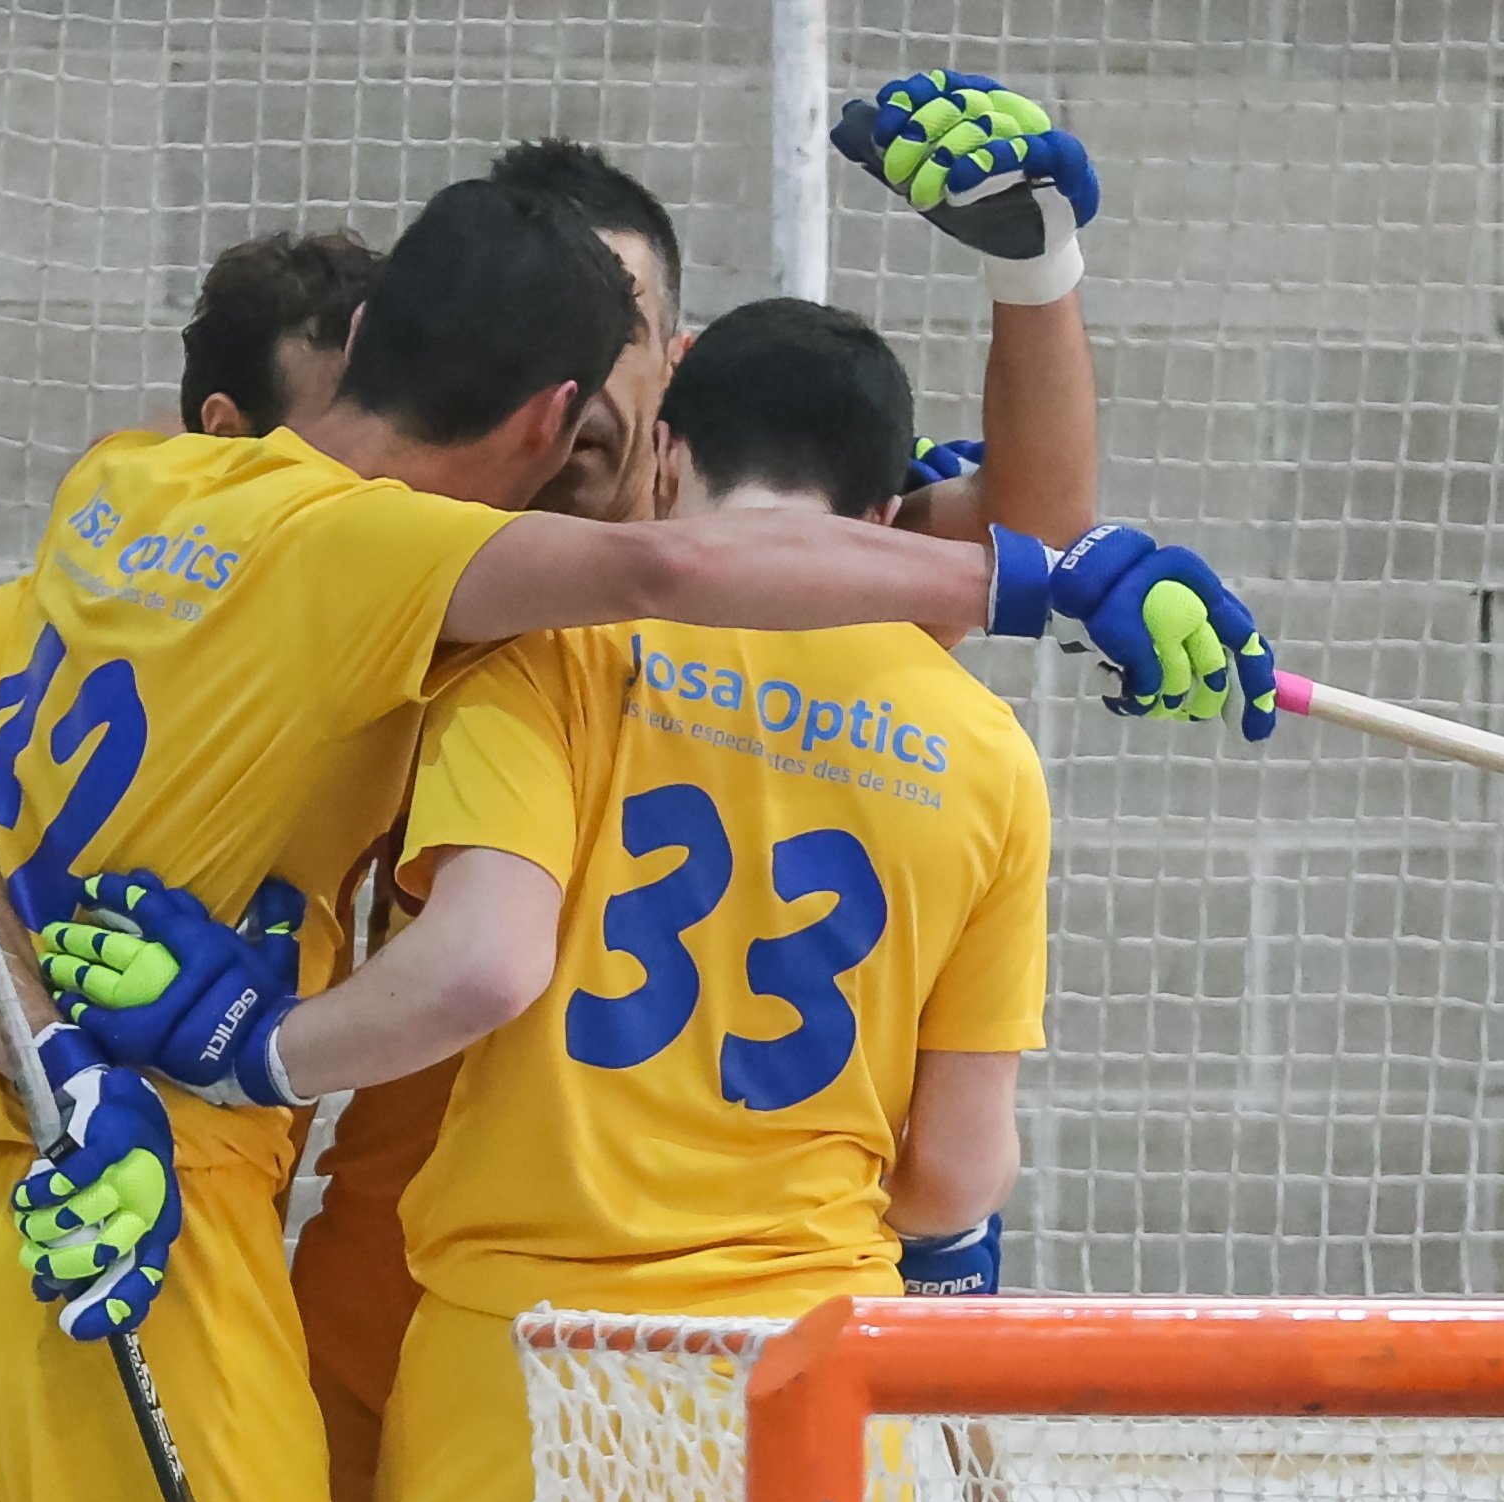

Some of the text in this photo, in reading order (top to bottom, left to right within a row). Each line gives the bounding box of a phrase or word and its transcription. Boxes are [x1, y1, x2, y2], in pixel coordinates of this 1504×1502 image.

[627, 634, 949, 773] Josa Optics
[858, 768, 884, 792] de
[893, 778, 943, 811] 1934
[565, 783, 888, 1111] 33
